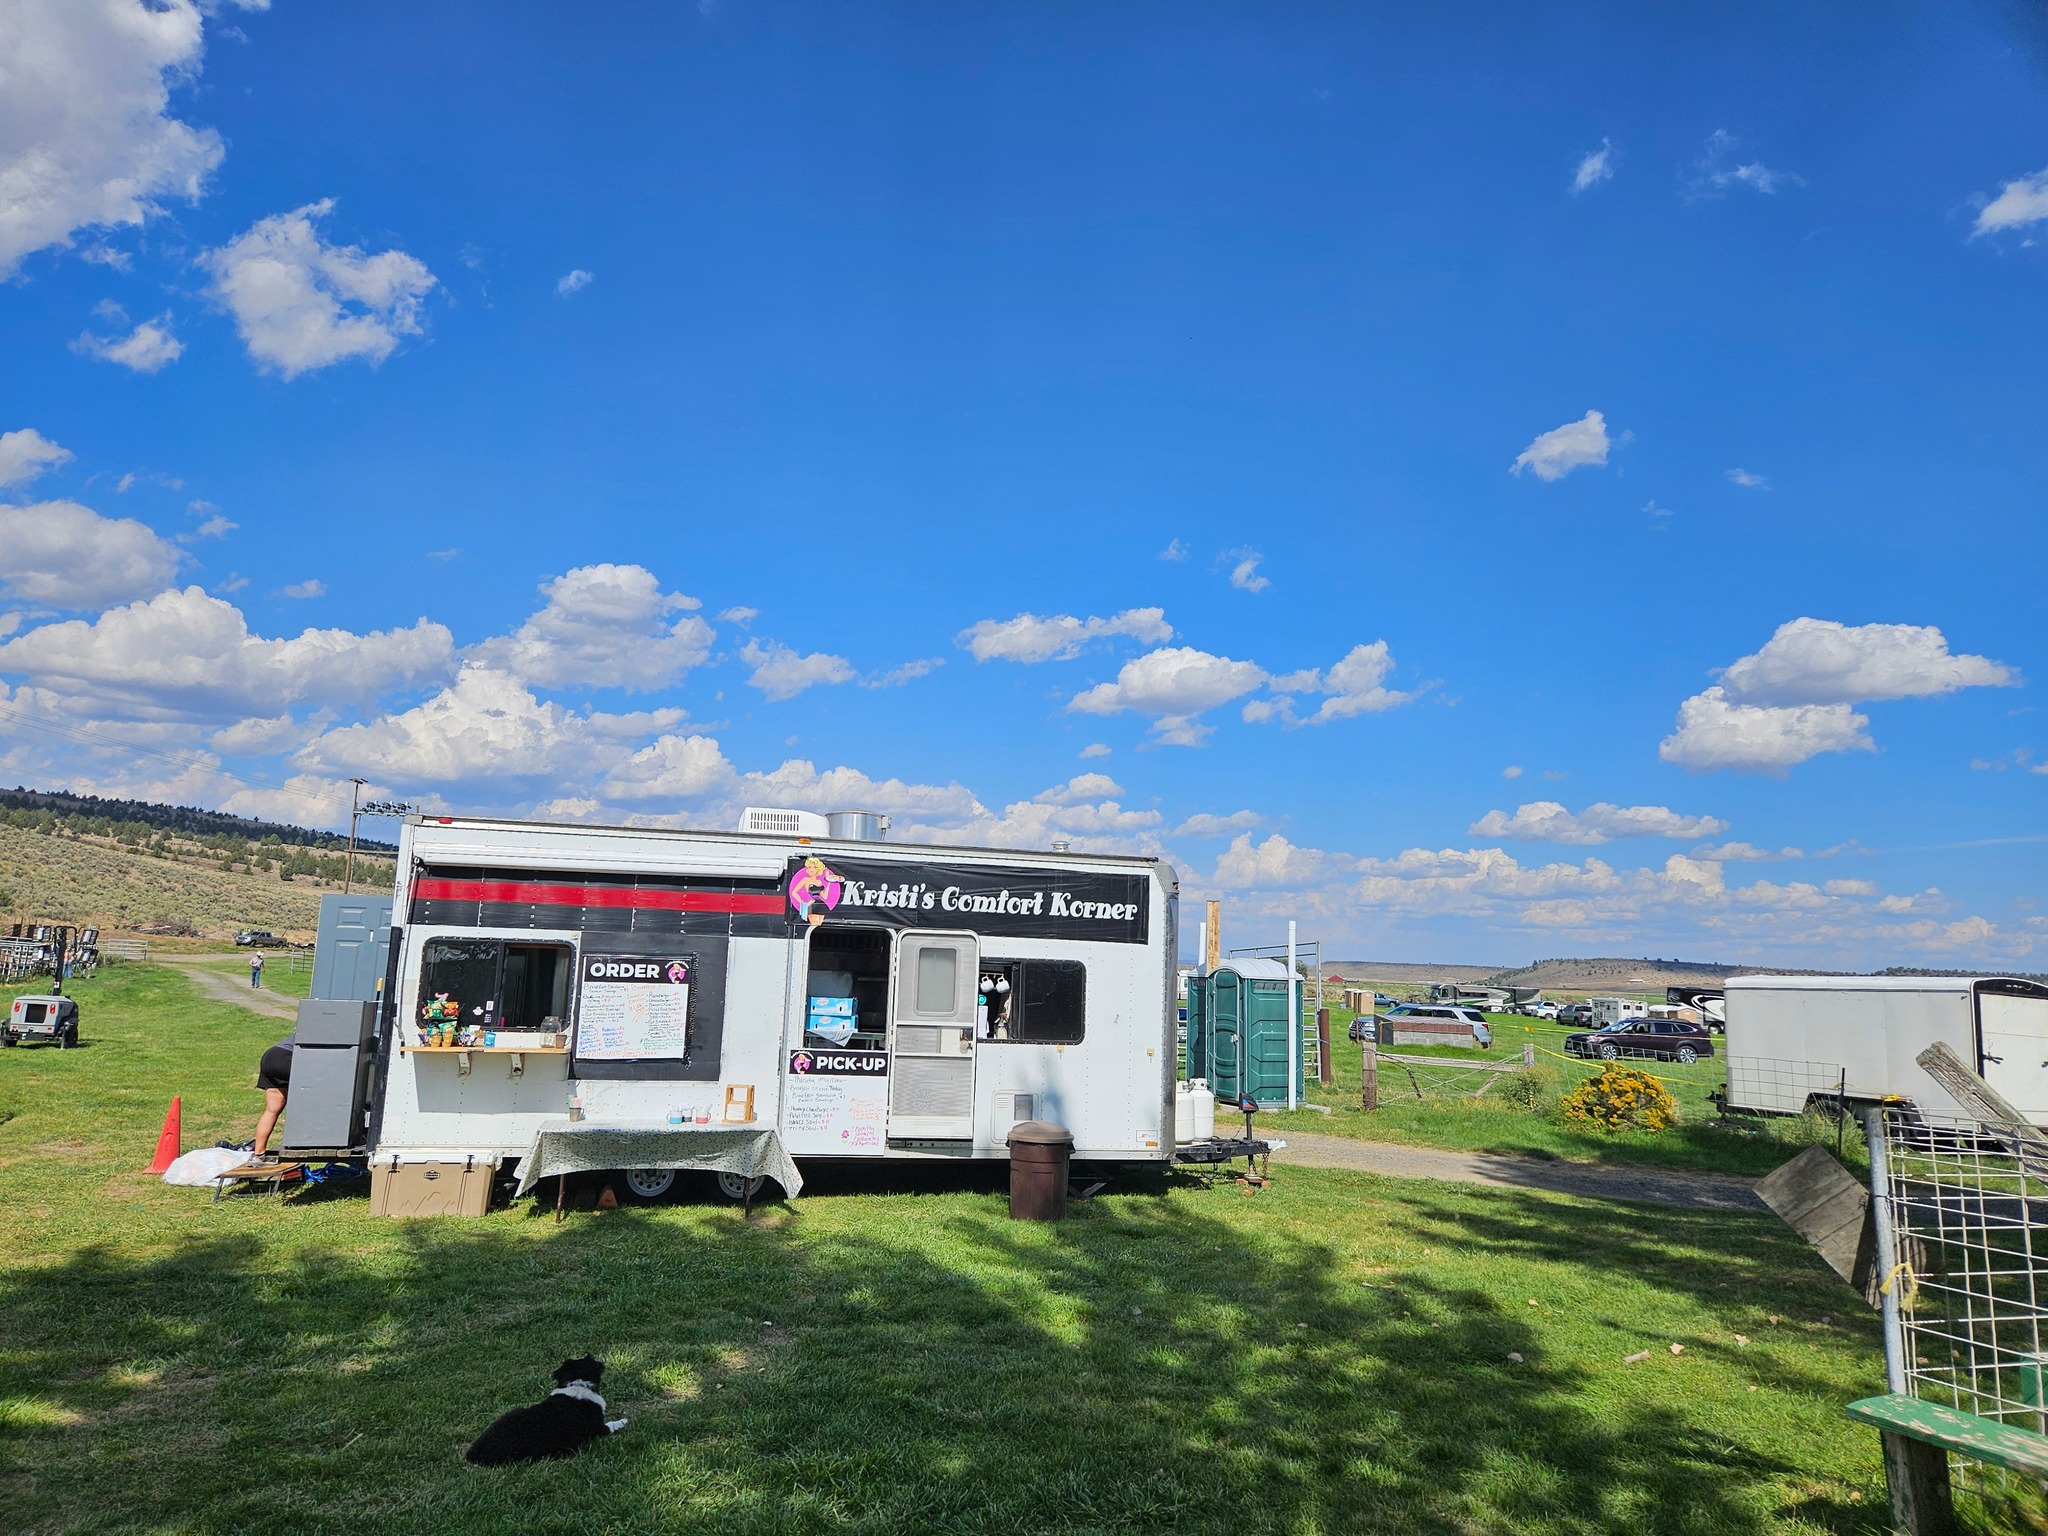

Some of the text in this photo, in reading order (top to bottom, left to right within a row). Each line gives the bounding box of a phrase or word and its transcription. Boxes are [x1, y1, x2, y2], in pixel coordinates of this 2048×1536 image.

[841, 881, 1138, 920] Kristi's Comfort Korner
[590, 962, 660, 979] ORDER
[816, 1056, 886, 1071] PICK-UP
